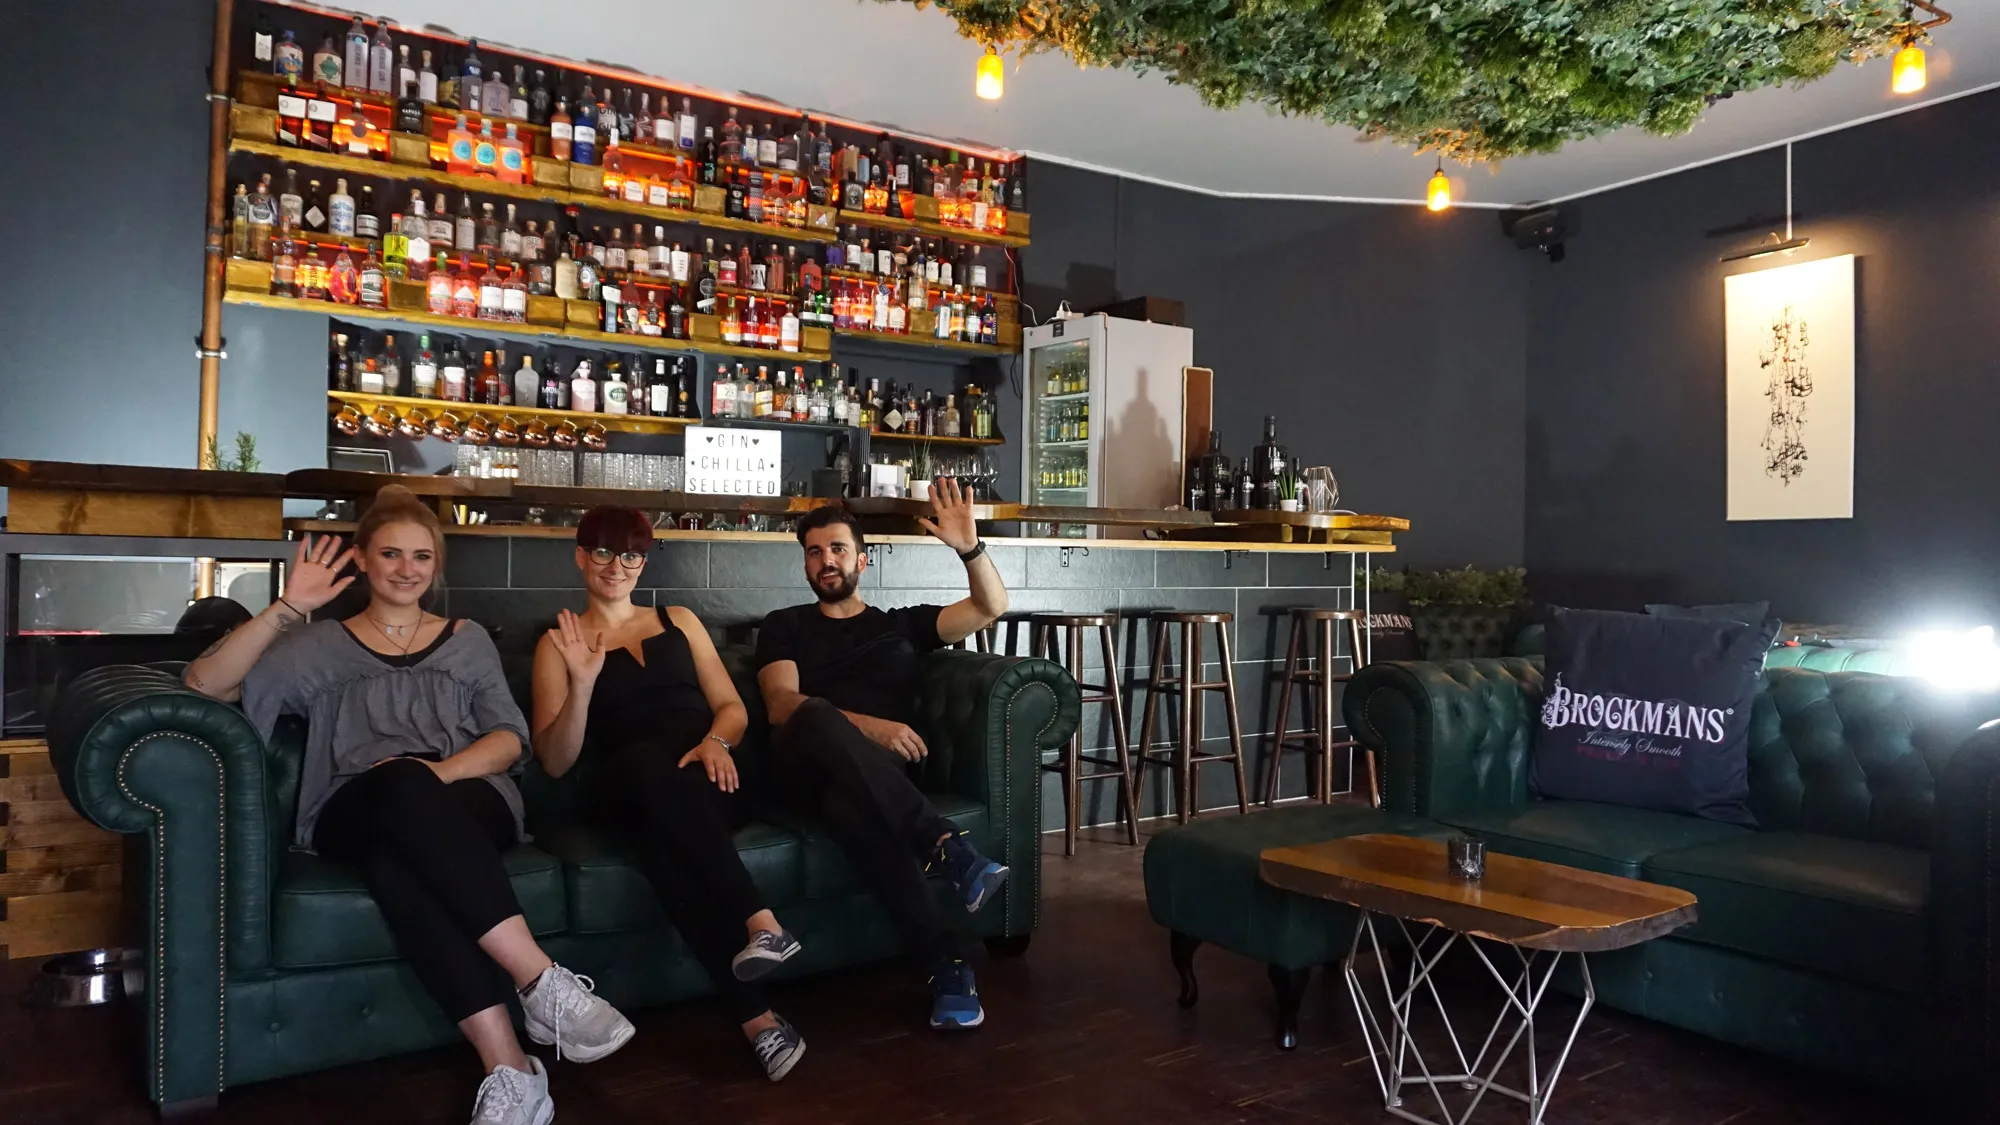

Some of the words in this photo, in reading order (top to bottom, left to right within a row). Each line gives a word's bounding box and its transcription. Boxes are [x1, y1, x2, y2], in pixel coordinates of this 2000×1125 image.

[717, 433, 748, 448] GIN
[701, 455, 765, 472] CHILLA
[689, 477, 775, 495] SELECTED
[1635, 738, 1682, 756] Smooth
